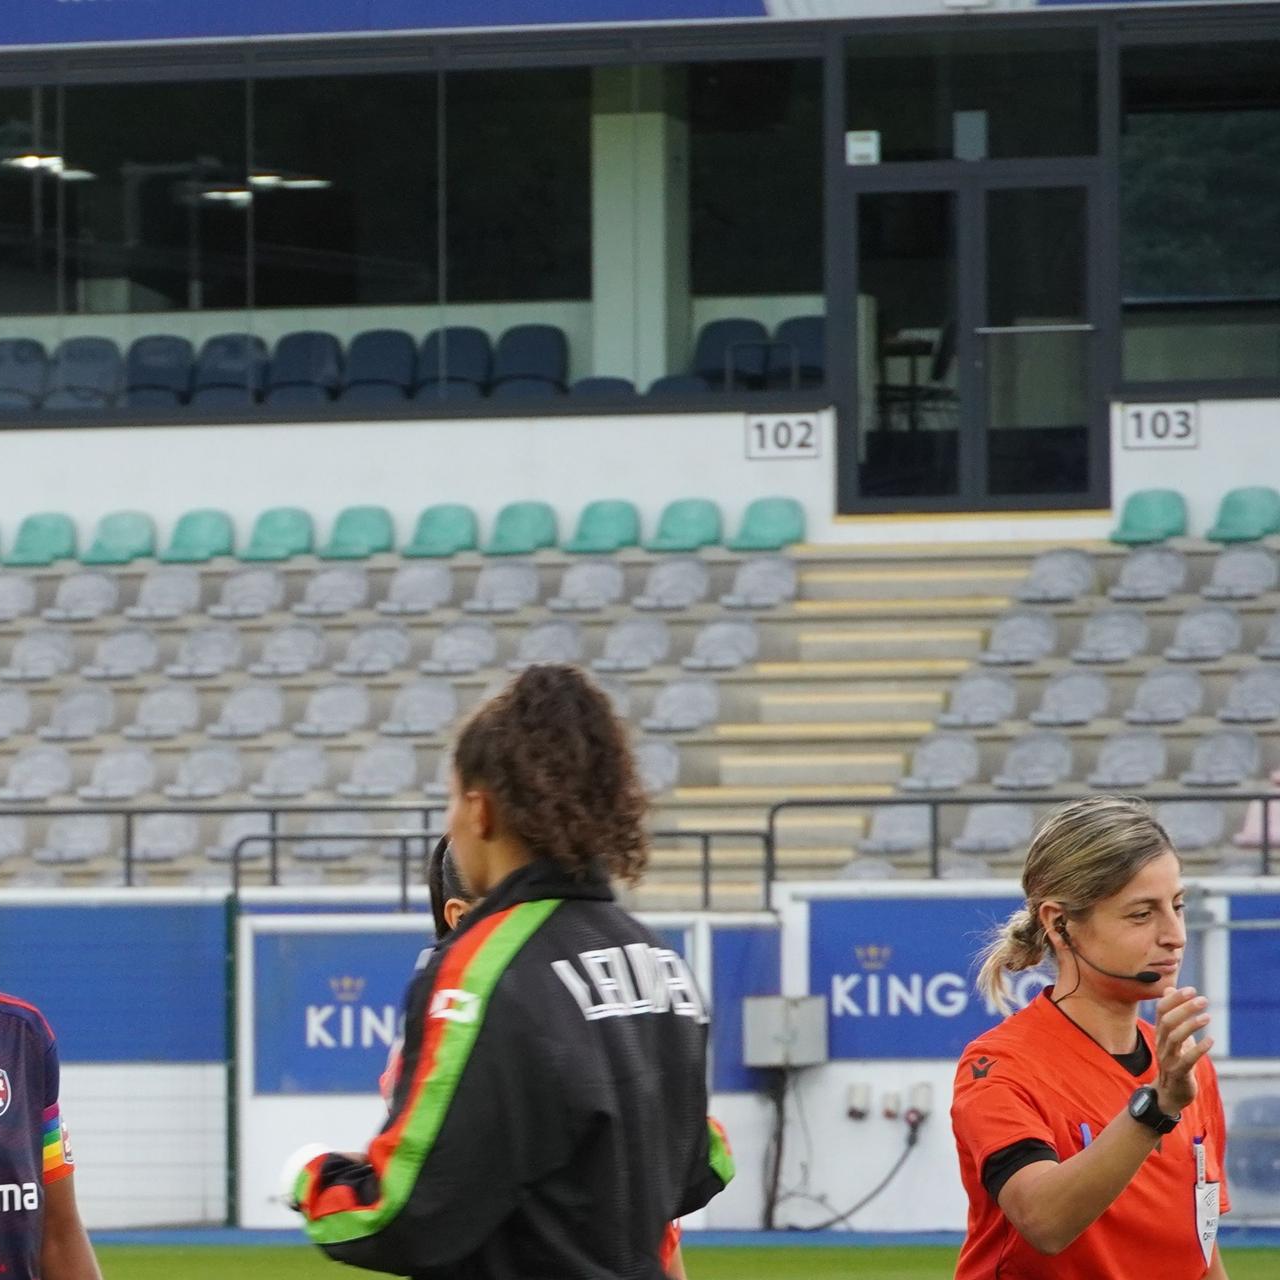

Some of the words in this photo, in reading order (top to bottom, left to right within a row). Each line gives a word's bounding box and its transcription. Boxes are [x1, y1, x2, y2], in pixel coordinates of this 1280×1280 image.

[752, 420, 815, 450] 102
[1129, 411, 1192, 441] 103
[832, 972, 969, 1017] KING
[305, 1004, 407, 1049] KIN
